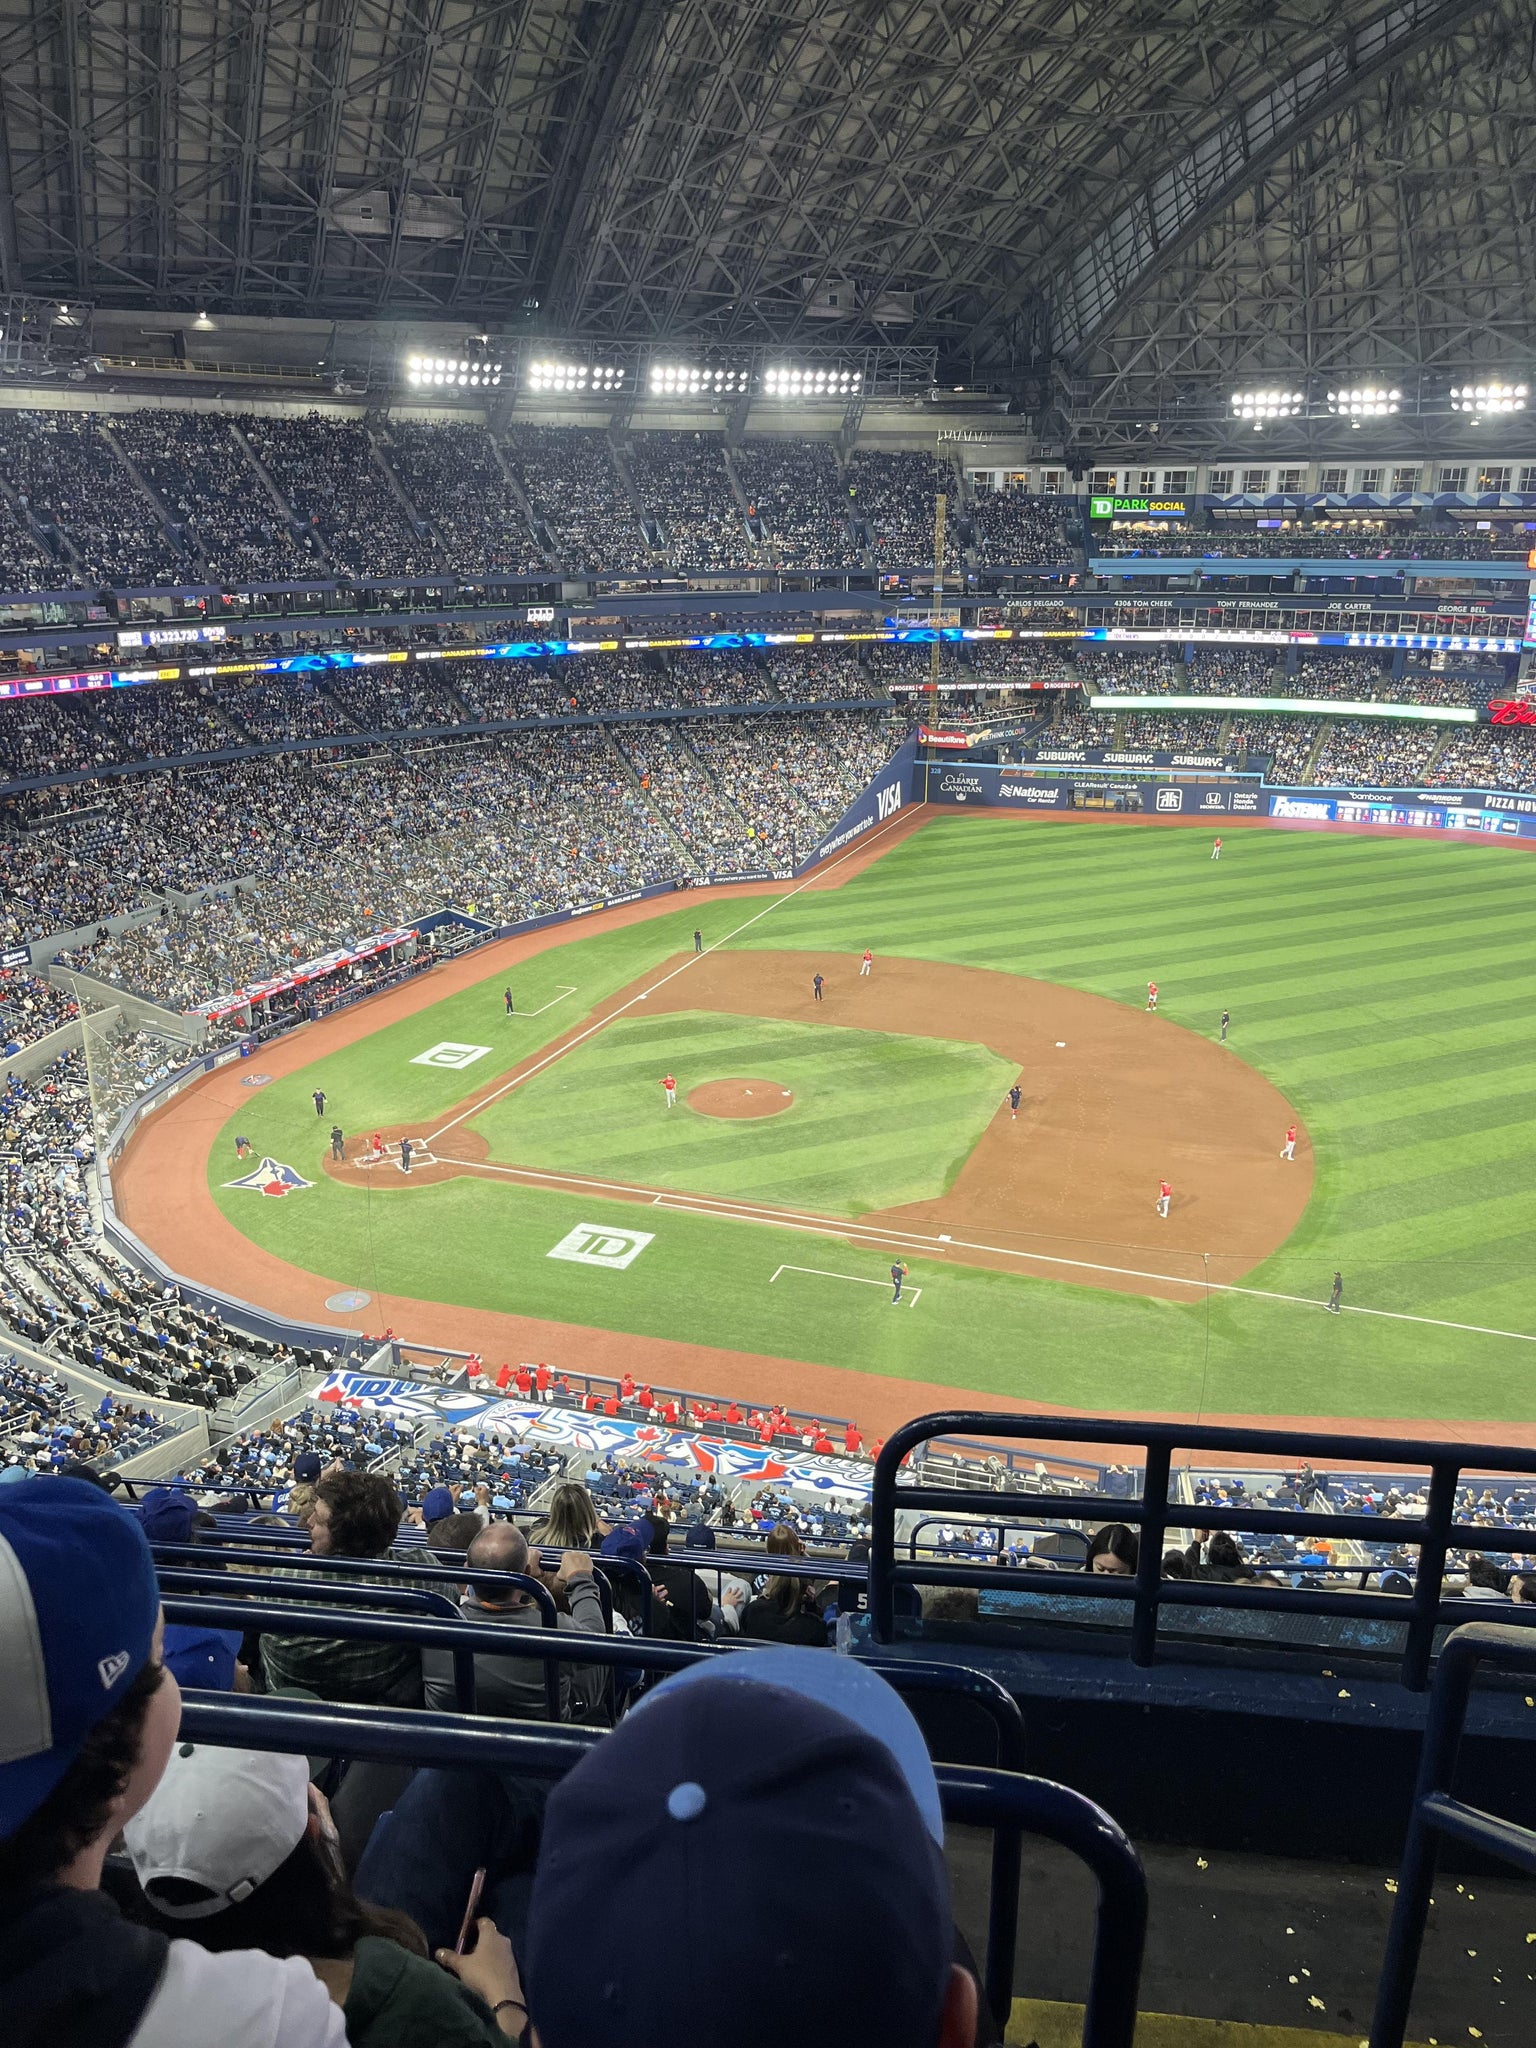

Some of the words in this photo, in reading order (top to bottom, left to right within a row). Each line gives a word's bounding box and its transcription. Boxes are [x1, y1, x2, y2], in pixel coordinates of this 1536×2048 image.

[1092, 499, 1113, 516] TD
[1114, 499, 1149, 510] PARK
[1149, 502, 1185, 511] SOCIAL
[1437, 605, 1467, 613] GEORGE
[986, 682, 1015, 690] CANADA'S
[1015, 682, 1031, 690] TEAM
[1004, 727, 1026, 738] COLOUR
[1035, 751, 1085, 762] SUBWAY
[1102, 753, 1153, 764] SUBWAY
[1171, 755, 1223, 767] SUBWAY
[945, 775, 980, 786] CLEARLY
[940, 782, 983, 793] CANADIAN
[876, 781, 901, 821] VISA
[1484, 795, 1515, 810] PIZZA
[772, 870, 793, 880] VISA
[572, 1227, 641, 1261] TD
[981, 1536, 992, 1547] 30
[857, 1592, 868, 1610] 5
